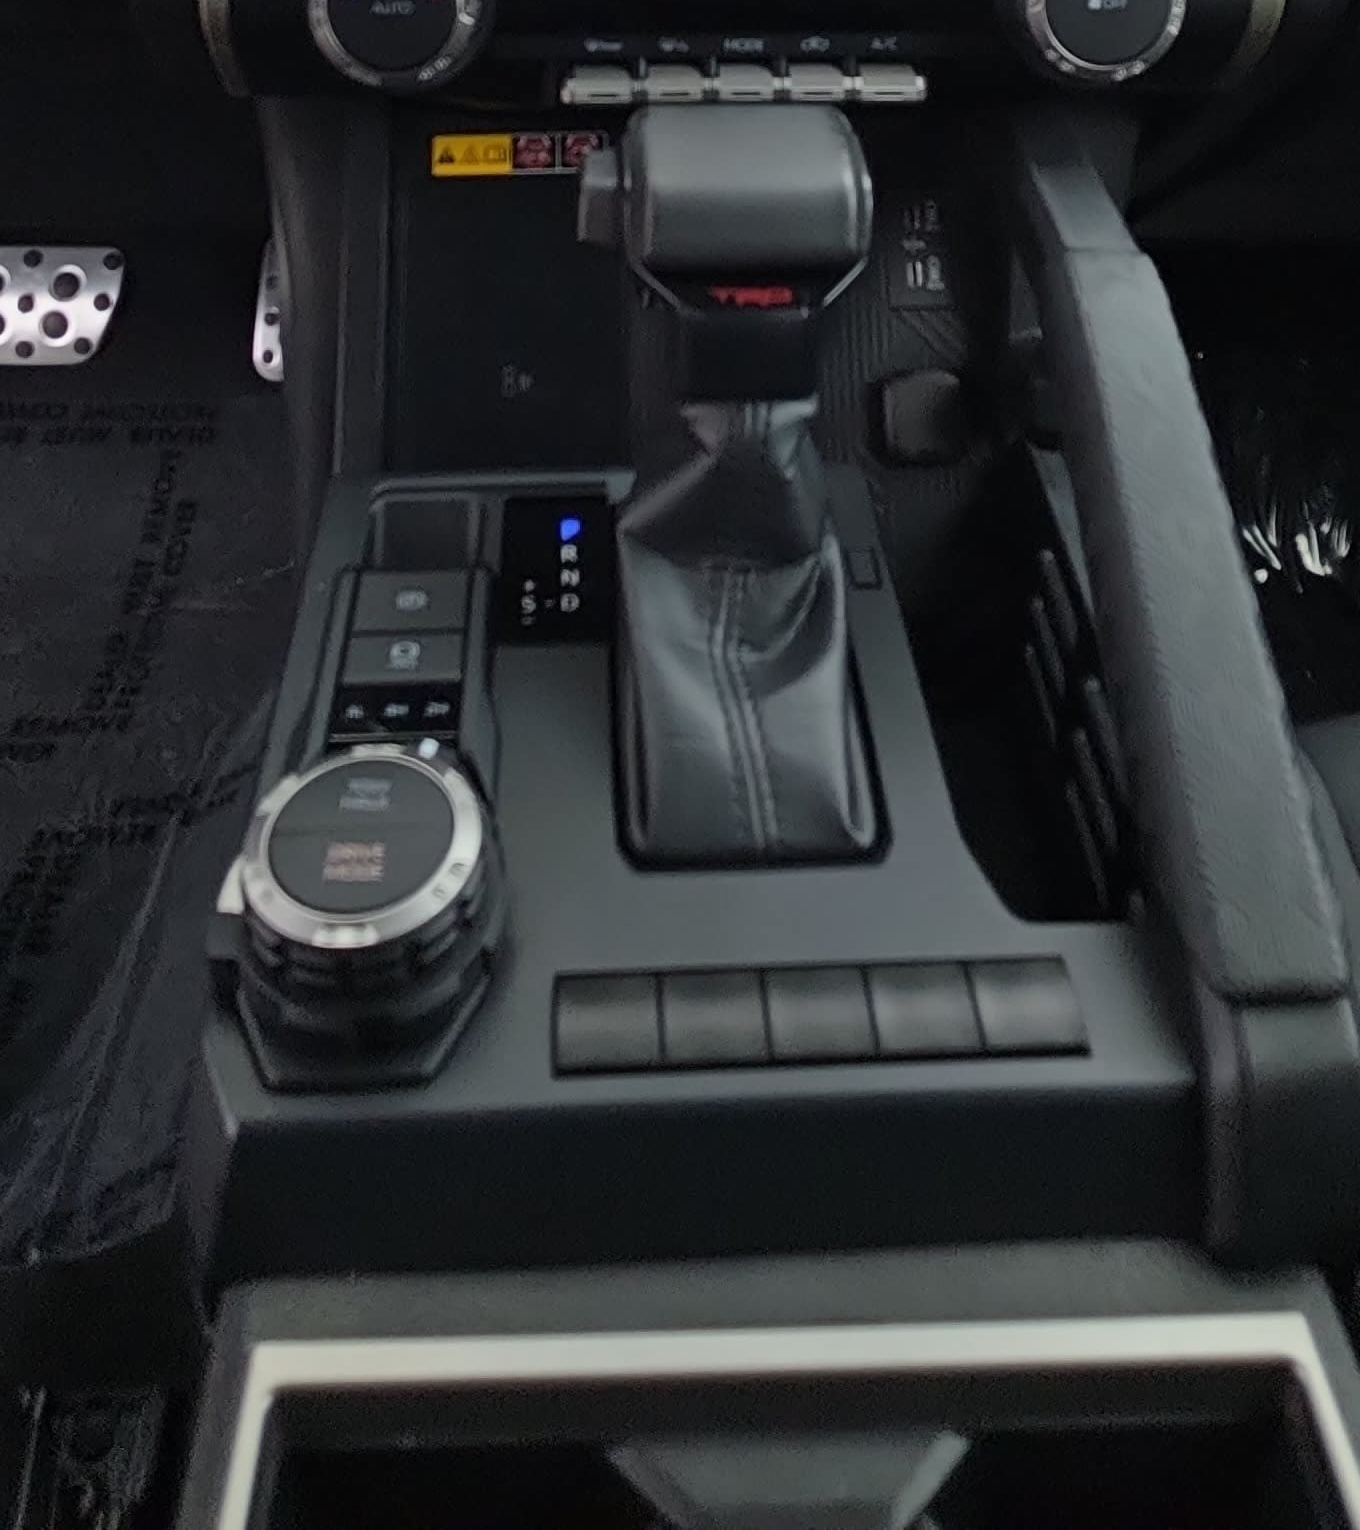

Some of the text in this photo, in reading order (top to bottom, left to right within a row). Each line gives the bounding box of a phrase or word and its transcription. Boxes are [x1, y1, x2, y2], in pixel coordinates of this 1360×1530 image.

[369, 0, 417, 16] AUTO
[560, 518, 580, 542] P
[560, 543, 578, 564] R
[560, 568, 580, 587] N
[560, 592, 580, 613] D
